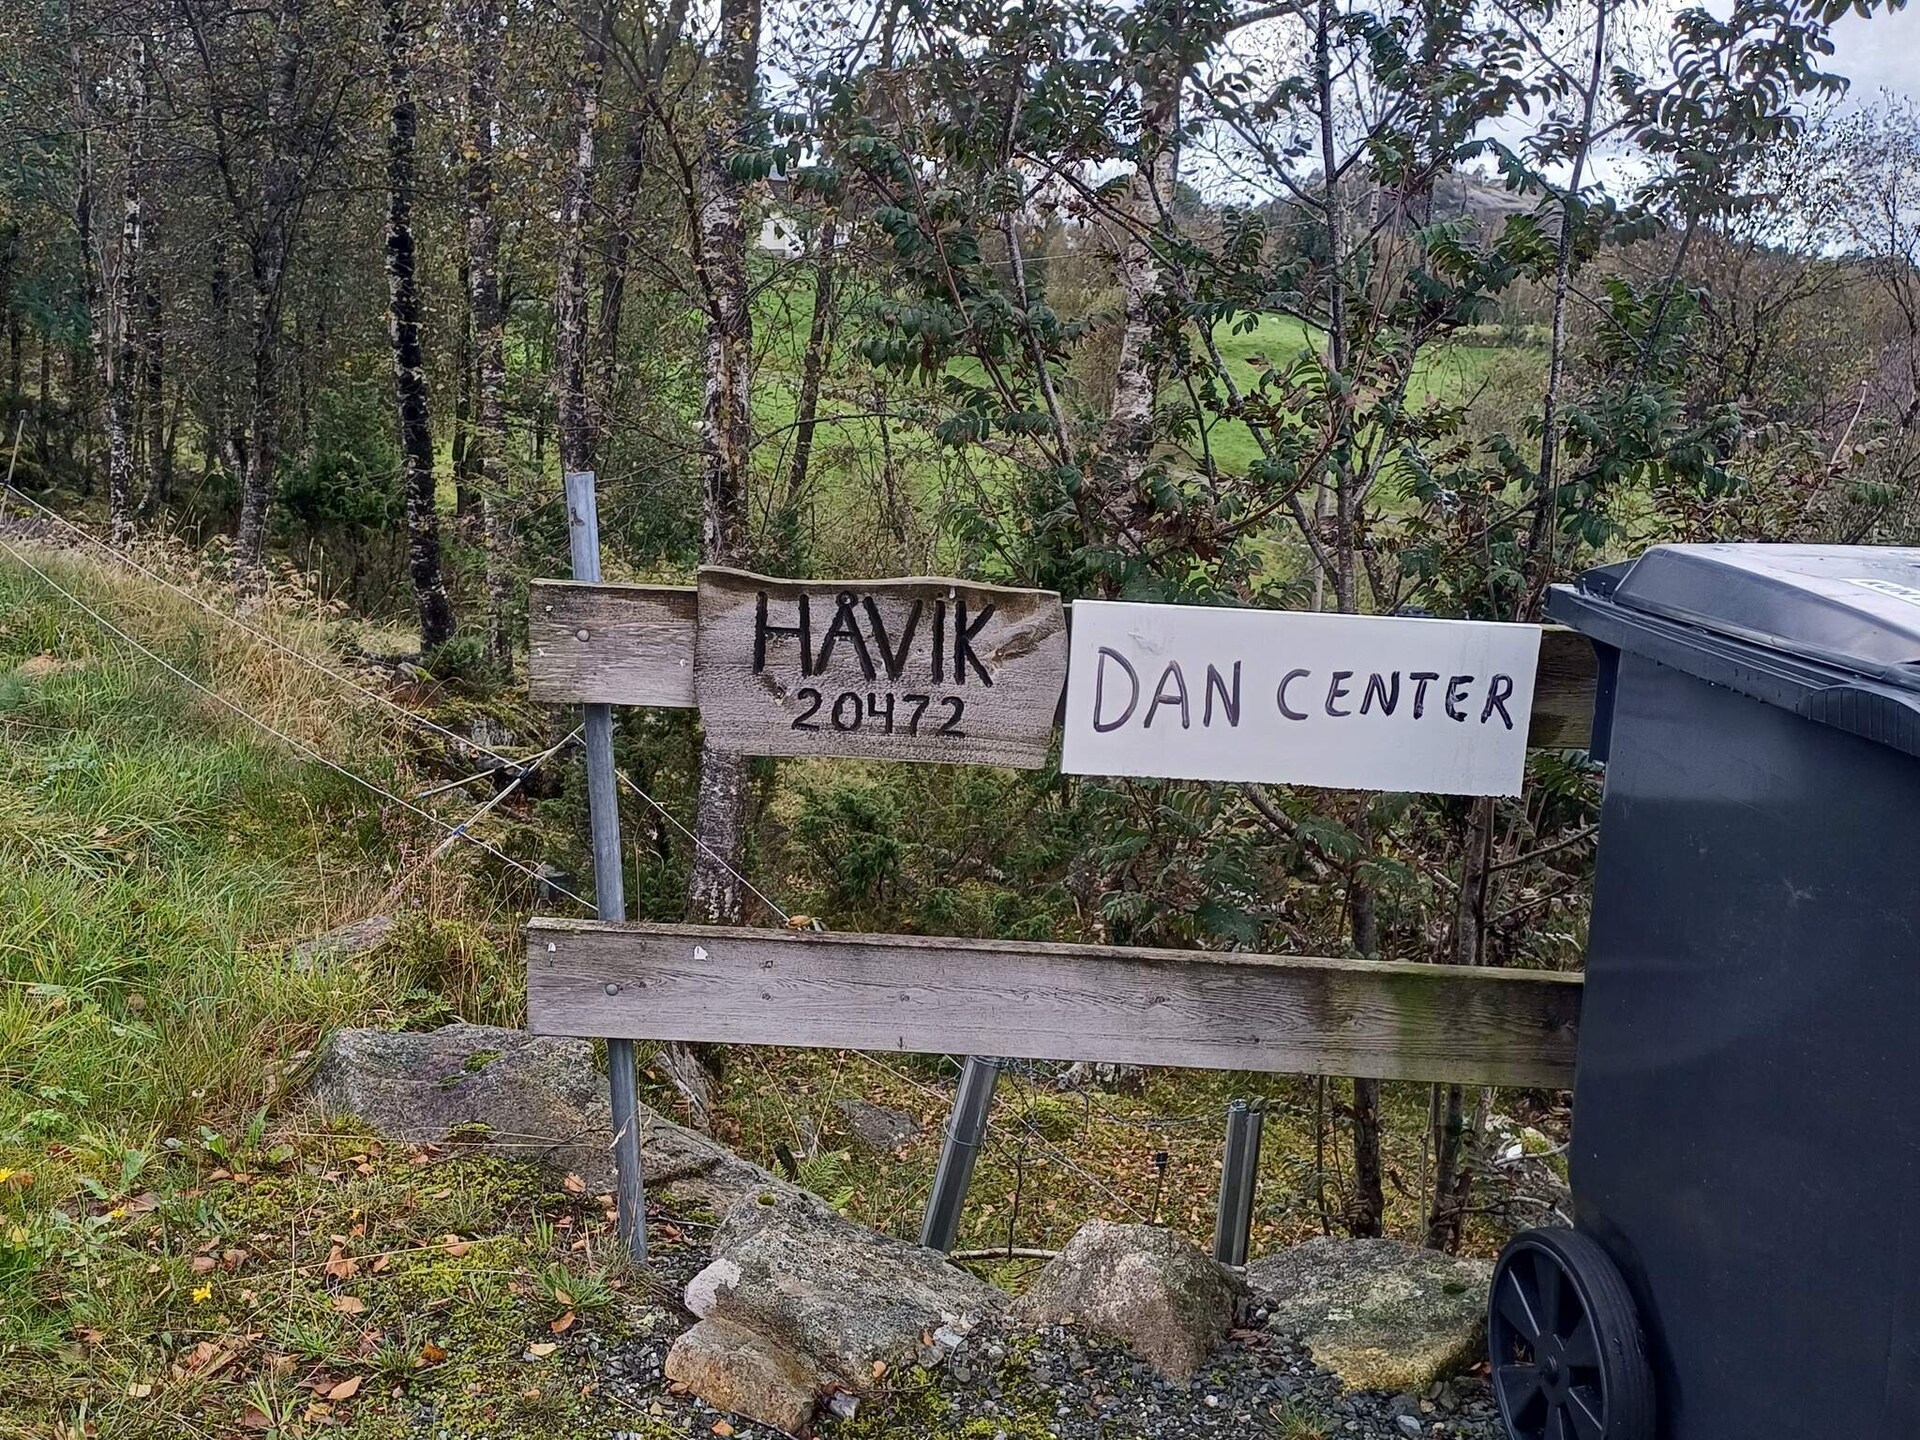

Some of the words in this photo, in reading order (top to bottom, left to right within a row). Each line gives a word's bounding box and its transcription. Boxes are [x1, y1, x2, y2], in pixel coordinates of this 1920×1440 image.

[752, 590, 994, 688] HÅVIK
[791, 688, 966, 738] 20472
[1093, 646, 1241, 733] DAN
[1276, 668, 1514, 730] CENTER
